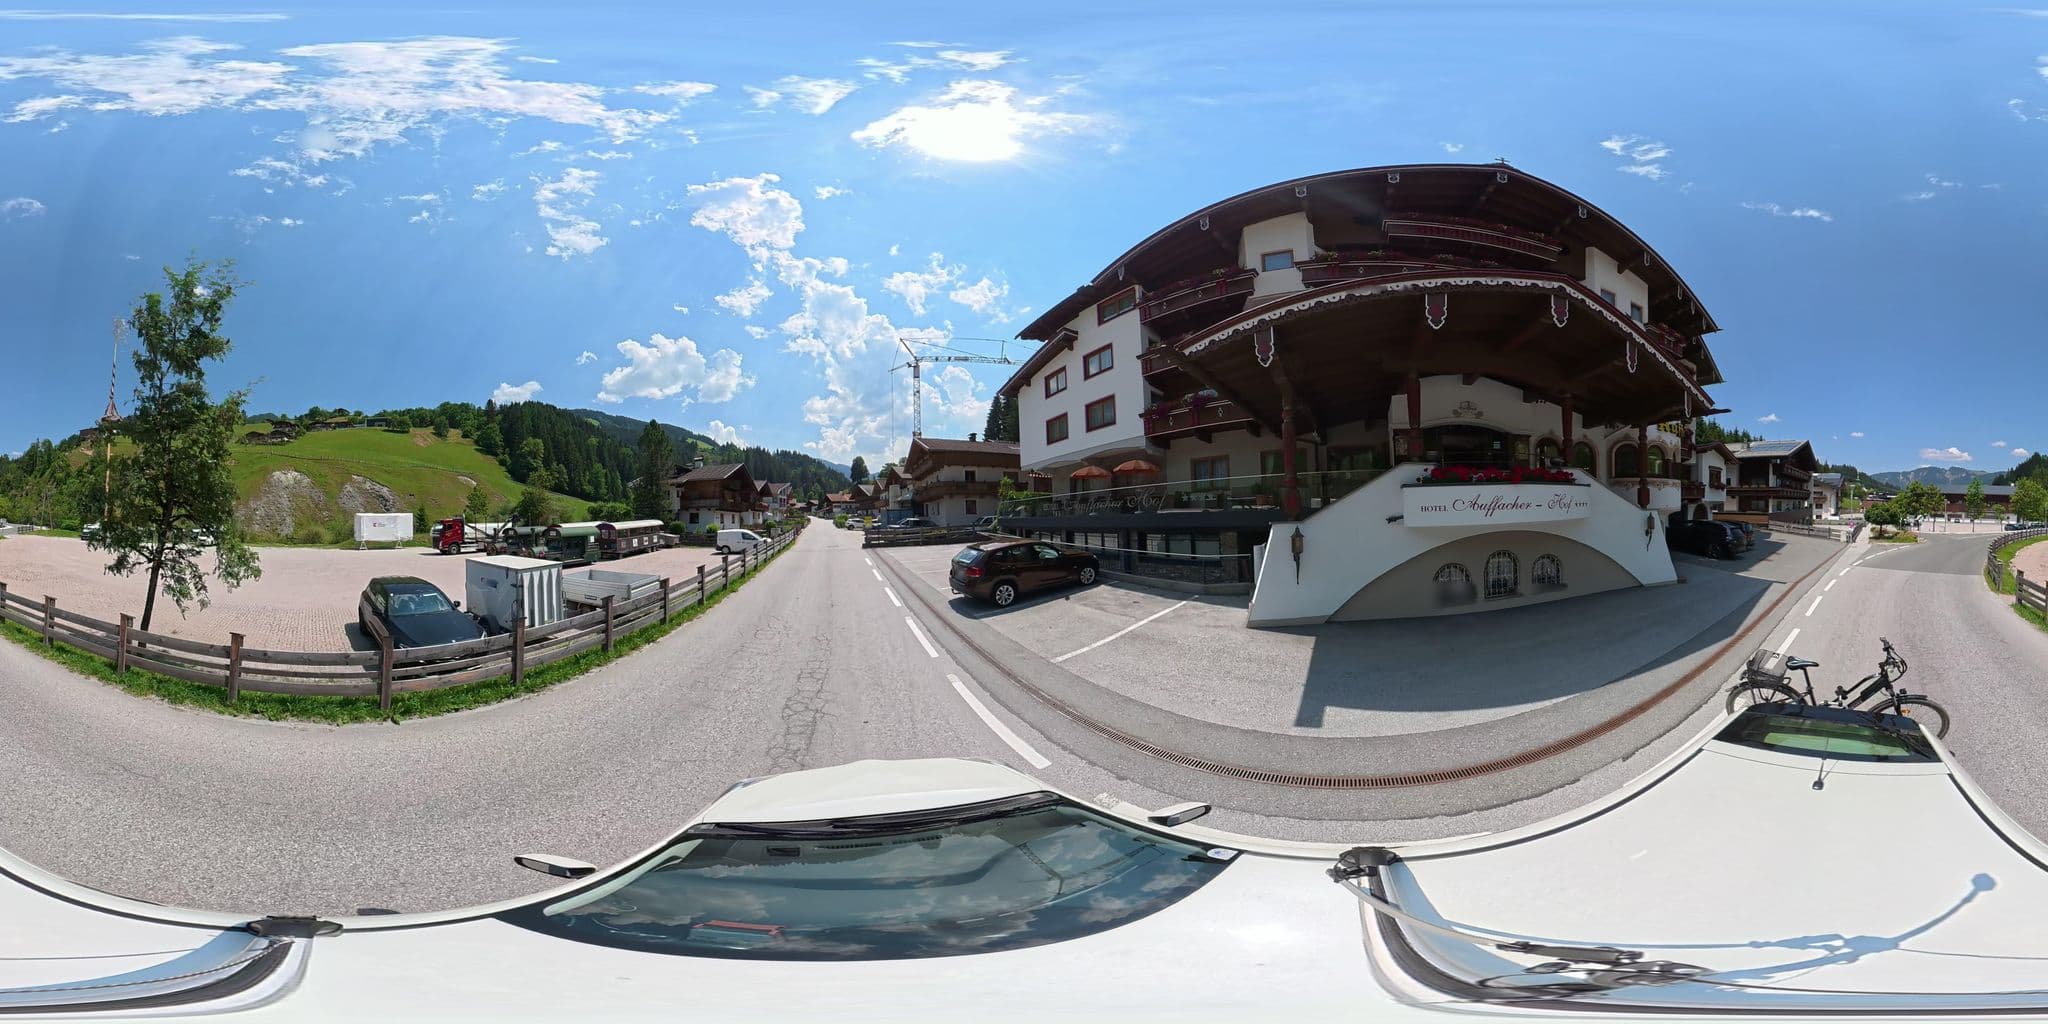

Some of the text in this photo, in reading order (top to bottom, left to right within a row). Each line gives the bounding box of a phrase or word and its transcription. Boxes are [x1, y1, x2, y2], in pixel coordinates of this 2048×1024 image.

[1420, 504, 1449, 513] HOTEL
[1452, 493, 1533, 517] Auffacher
[1547, 492, 1573, 514] Hof
